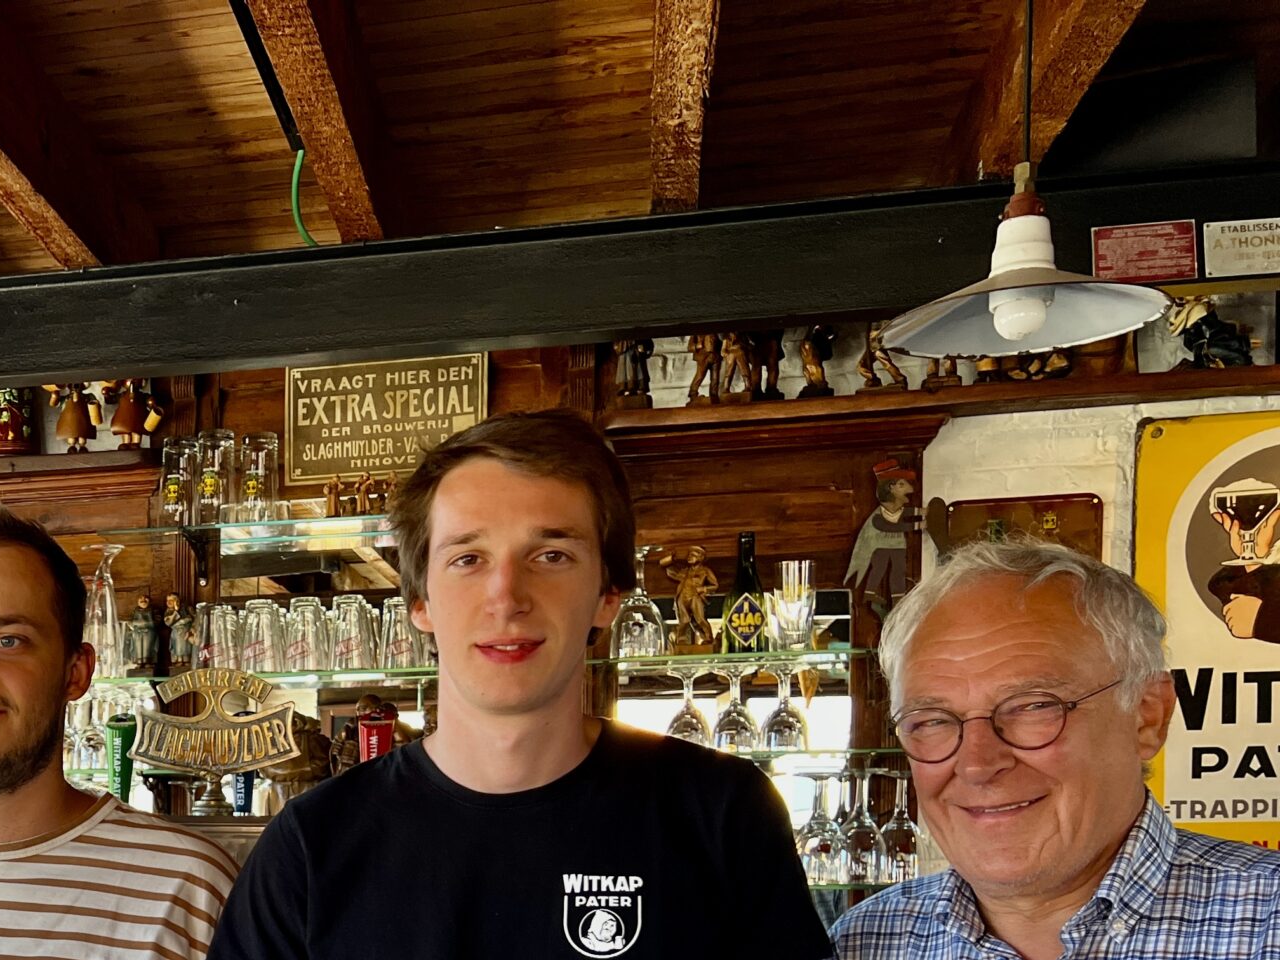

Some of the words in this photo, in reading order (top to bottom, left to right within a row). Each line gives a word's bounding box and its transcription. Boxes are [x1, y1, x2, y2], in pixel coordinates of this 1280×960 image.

[297, 373, 377, 394] VRAAGT
[385, 369, 431, 387] HIER
[437, 365, 474, 383] DEN
[297, 392, 378, 427] EXTRA
[382, 384, 475, 420] SPECIAL
[321, 426, 352, 438] DER
[362, 418, 450, 436] BROUWERIJ
[350, 454, 417, 469] NINOVE
[731, 611, 762, 628] SLAG
[168, 668, 265, 700] BIEREN
[562, 873, 644, 894] WITKAP
[575, 896, 633, 907] PATER
